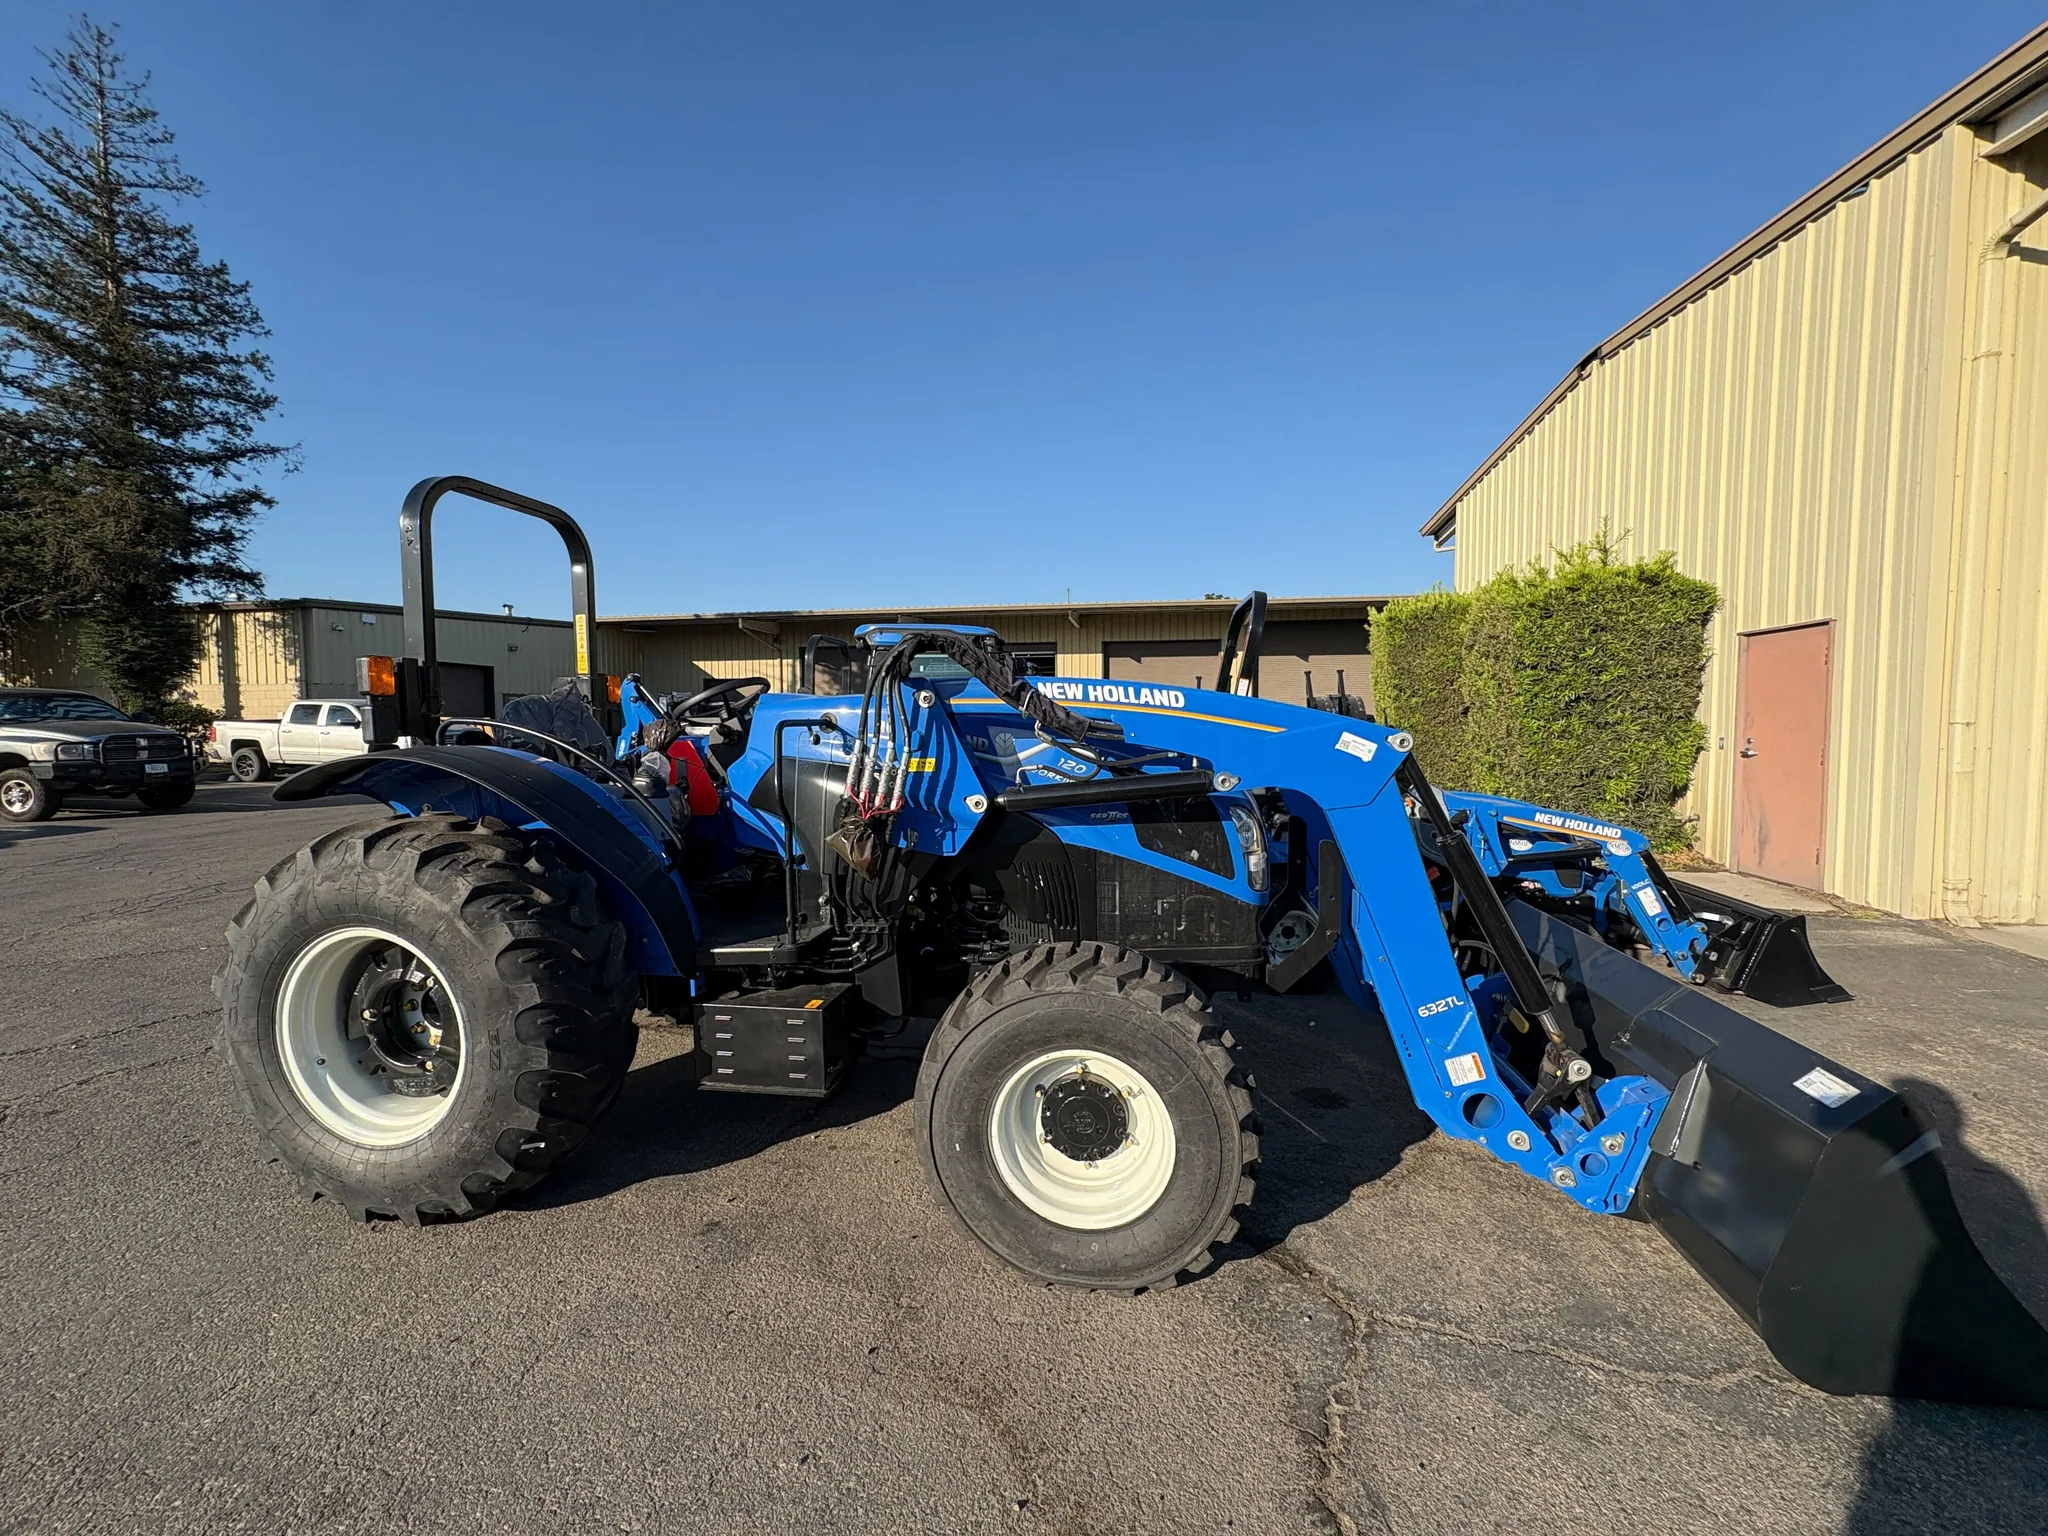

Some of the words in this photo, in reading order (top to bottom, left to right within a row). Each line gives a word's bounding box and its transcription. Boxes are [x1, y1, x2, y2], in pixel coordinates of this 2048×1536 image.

[1037, 681, 1083, 700] NEW
[1088, 685, 1185, 708] HOLLAND
[1057, 757, 1087, 774] 120
[1534, 812, 1565, 827] NEW
[1565, 820, 1622, 838] HOLLAND
[1417, 995, 1465, 1018] 632TL
